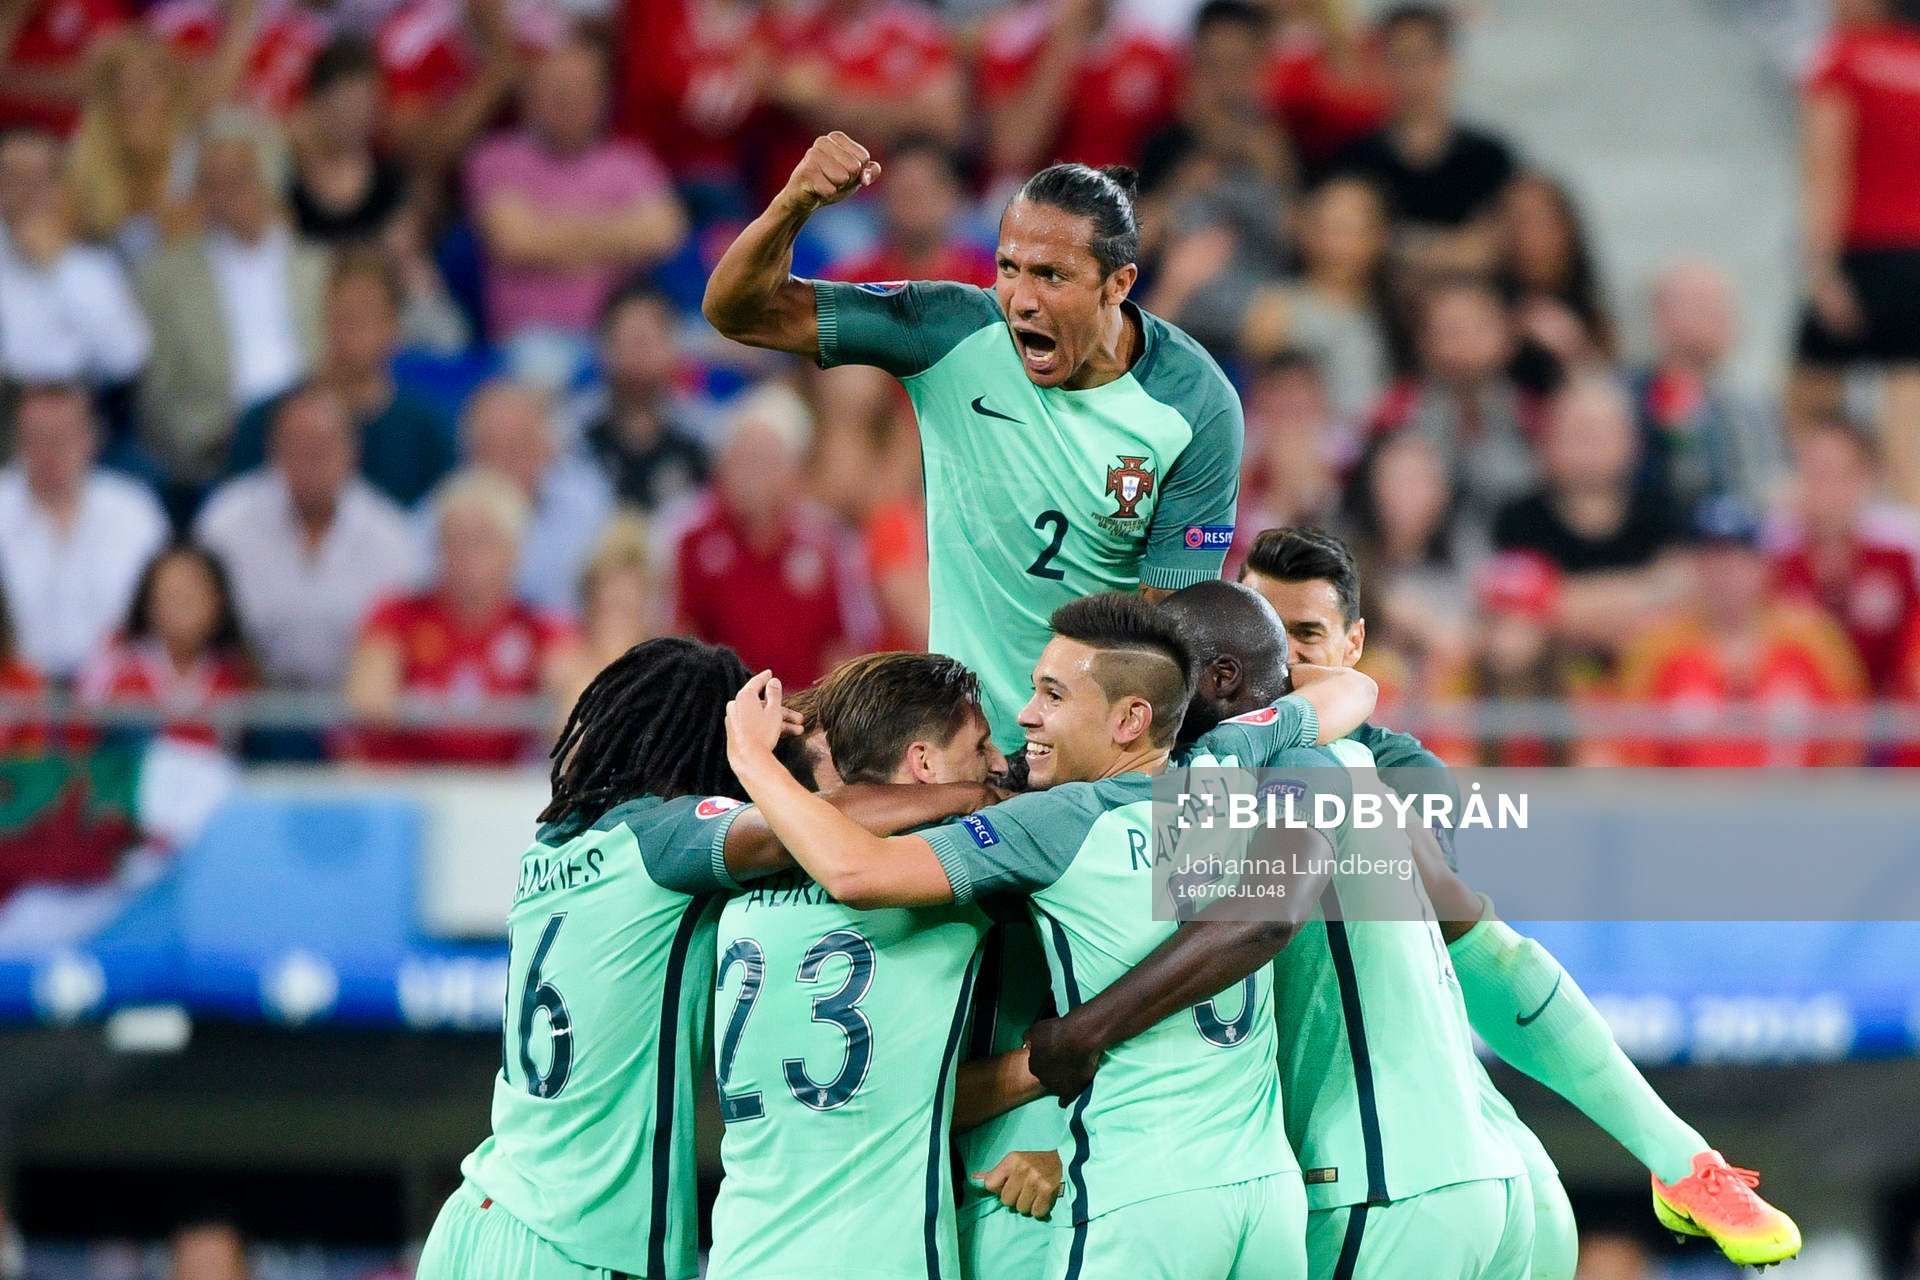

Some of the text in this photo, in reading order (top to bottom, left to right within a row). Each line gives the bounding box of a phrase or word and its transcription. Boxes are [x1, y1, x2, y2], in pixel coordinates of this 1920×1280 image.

[1026, 510, 1069, 581] 2
[1257, 784, 1305, 799] RESPECT
[503, 911, 574, 1100] 6
[716, 928, 876, 1124] 23
